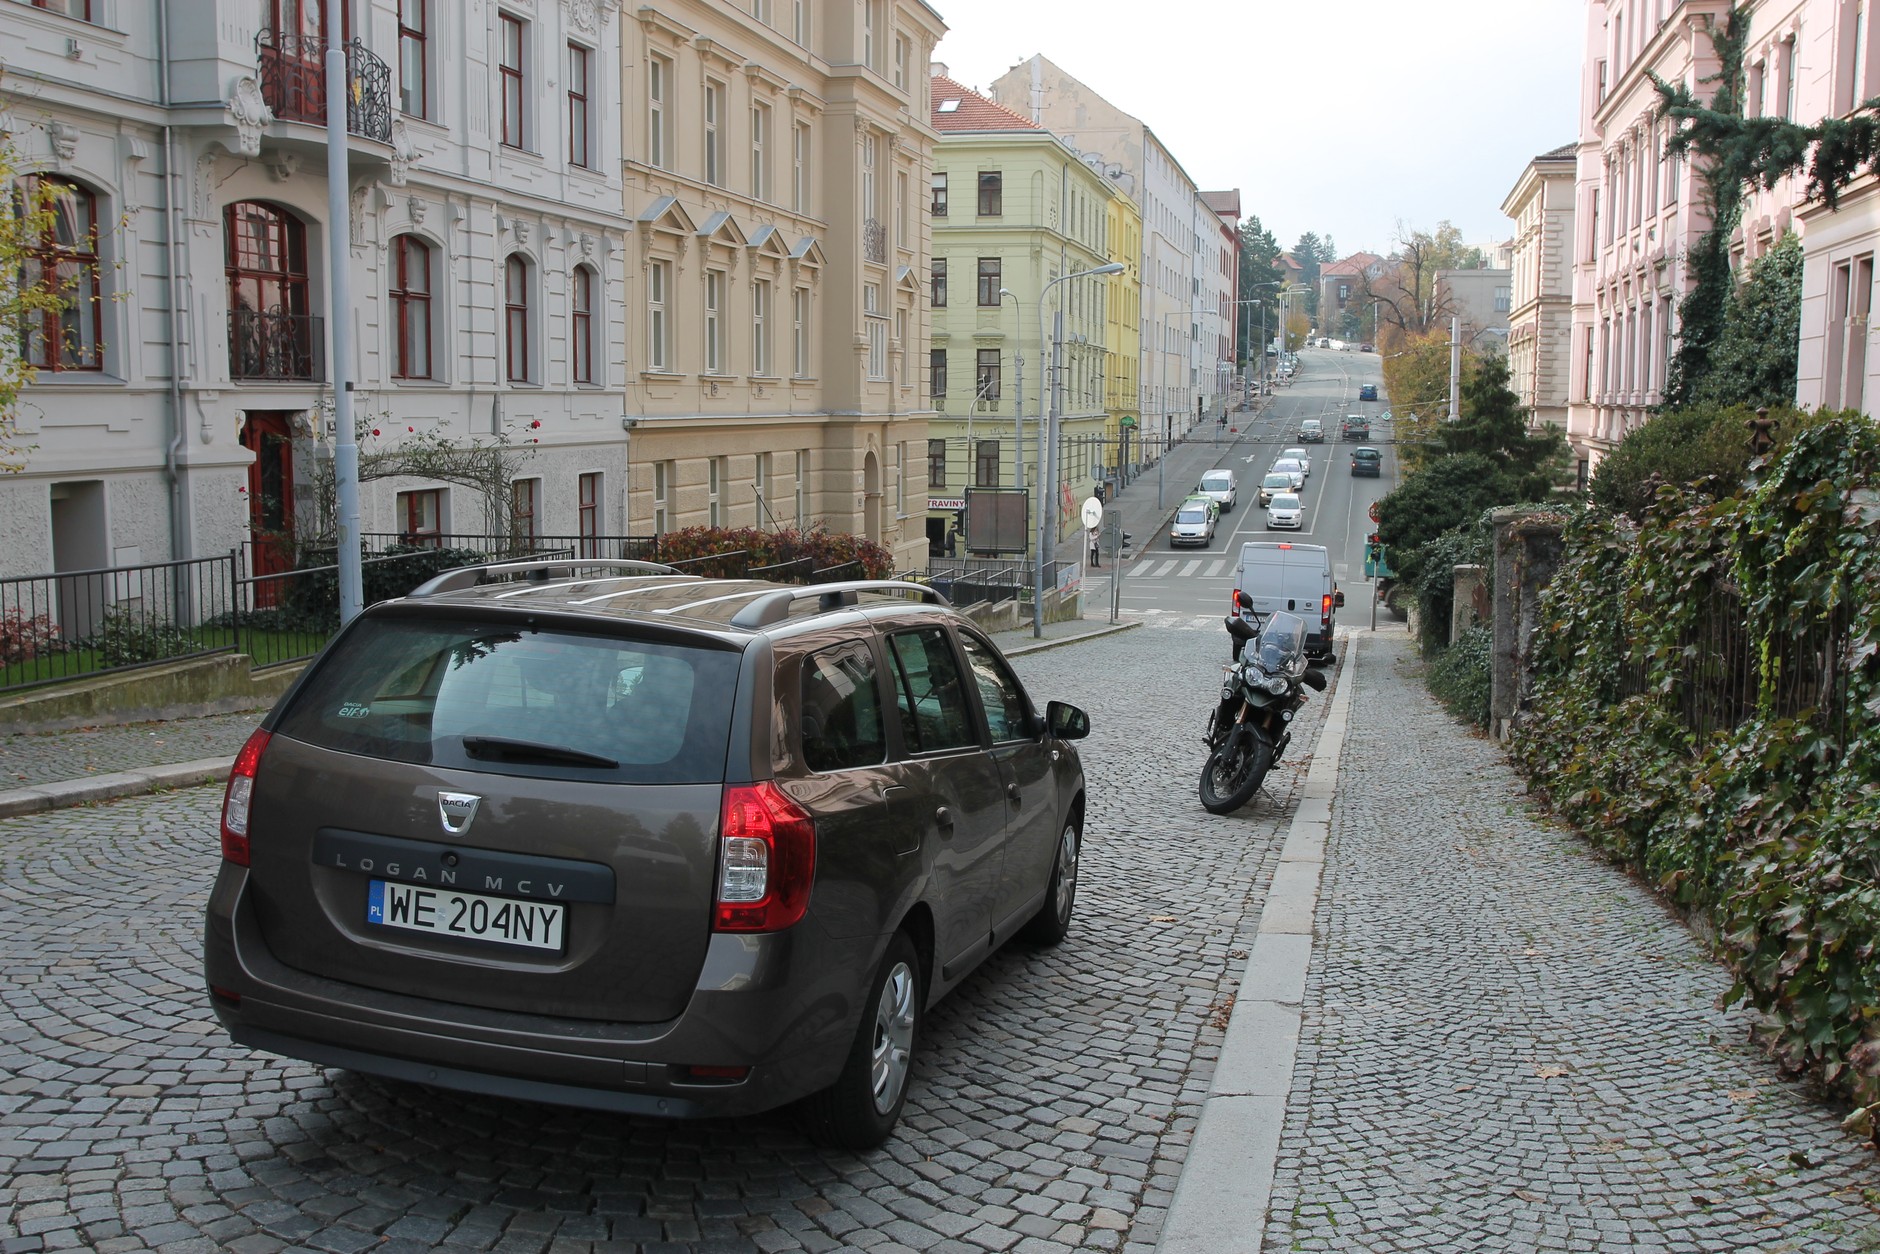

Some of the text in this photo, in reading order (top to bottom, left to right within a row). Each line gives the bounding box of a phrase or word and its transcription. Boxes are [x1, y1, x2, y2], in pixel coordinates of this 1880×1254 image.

[442, 799, 471, 809] DACIA
[335, 853, 457, 884] LOGAN
[370, 905, 382, 917] PL
[390, 886, 558, 944] WE 204NY
